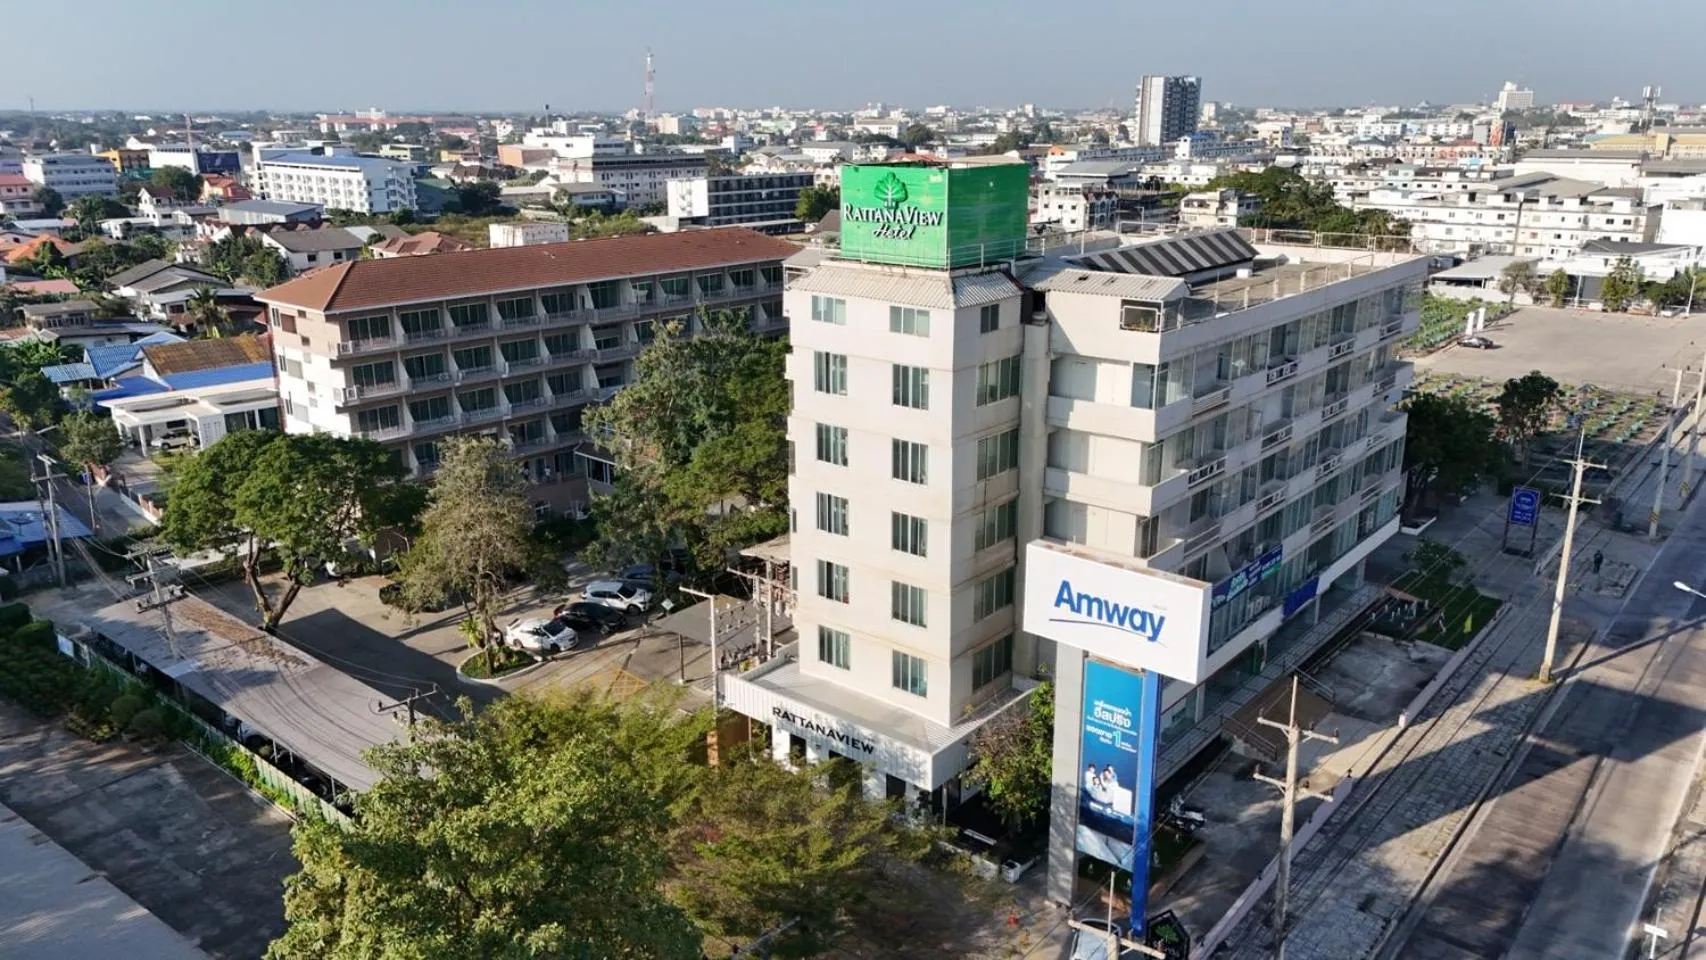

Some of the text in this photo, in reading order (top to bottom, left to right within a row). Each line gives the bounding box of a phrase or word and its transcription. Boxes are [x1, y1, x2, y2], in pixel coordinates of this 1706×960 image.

[873, 223, 917, 240] Hotel
[1054, 580, 1166, 642] Amway
[772, 706, 874, 755] RATTANAVIEW
